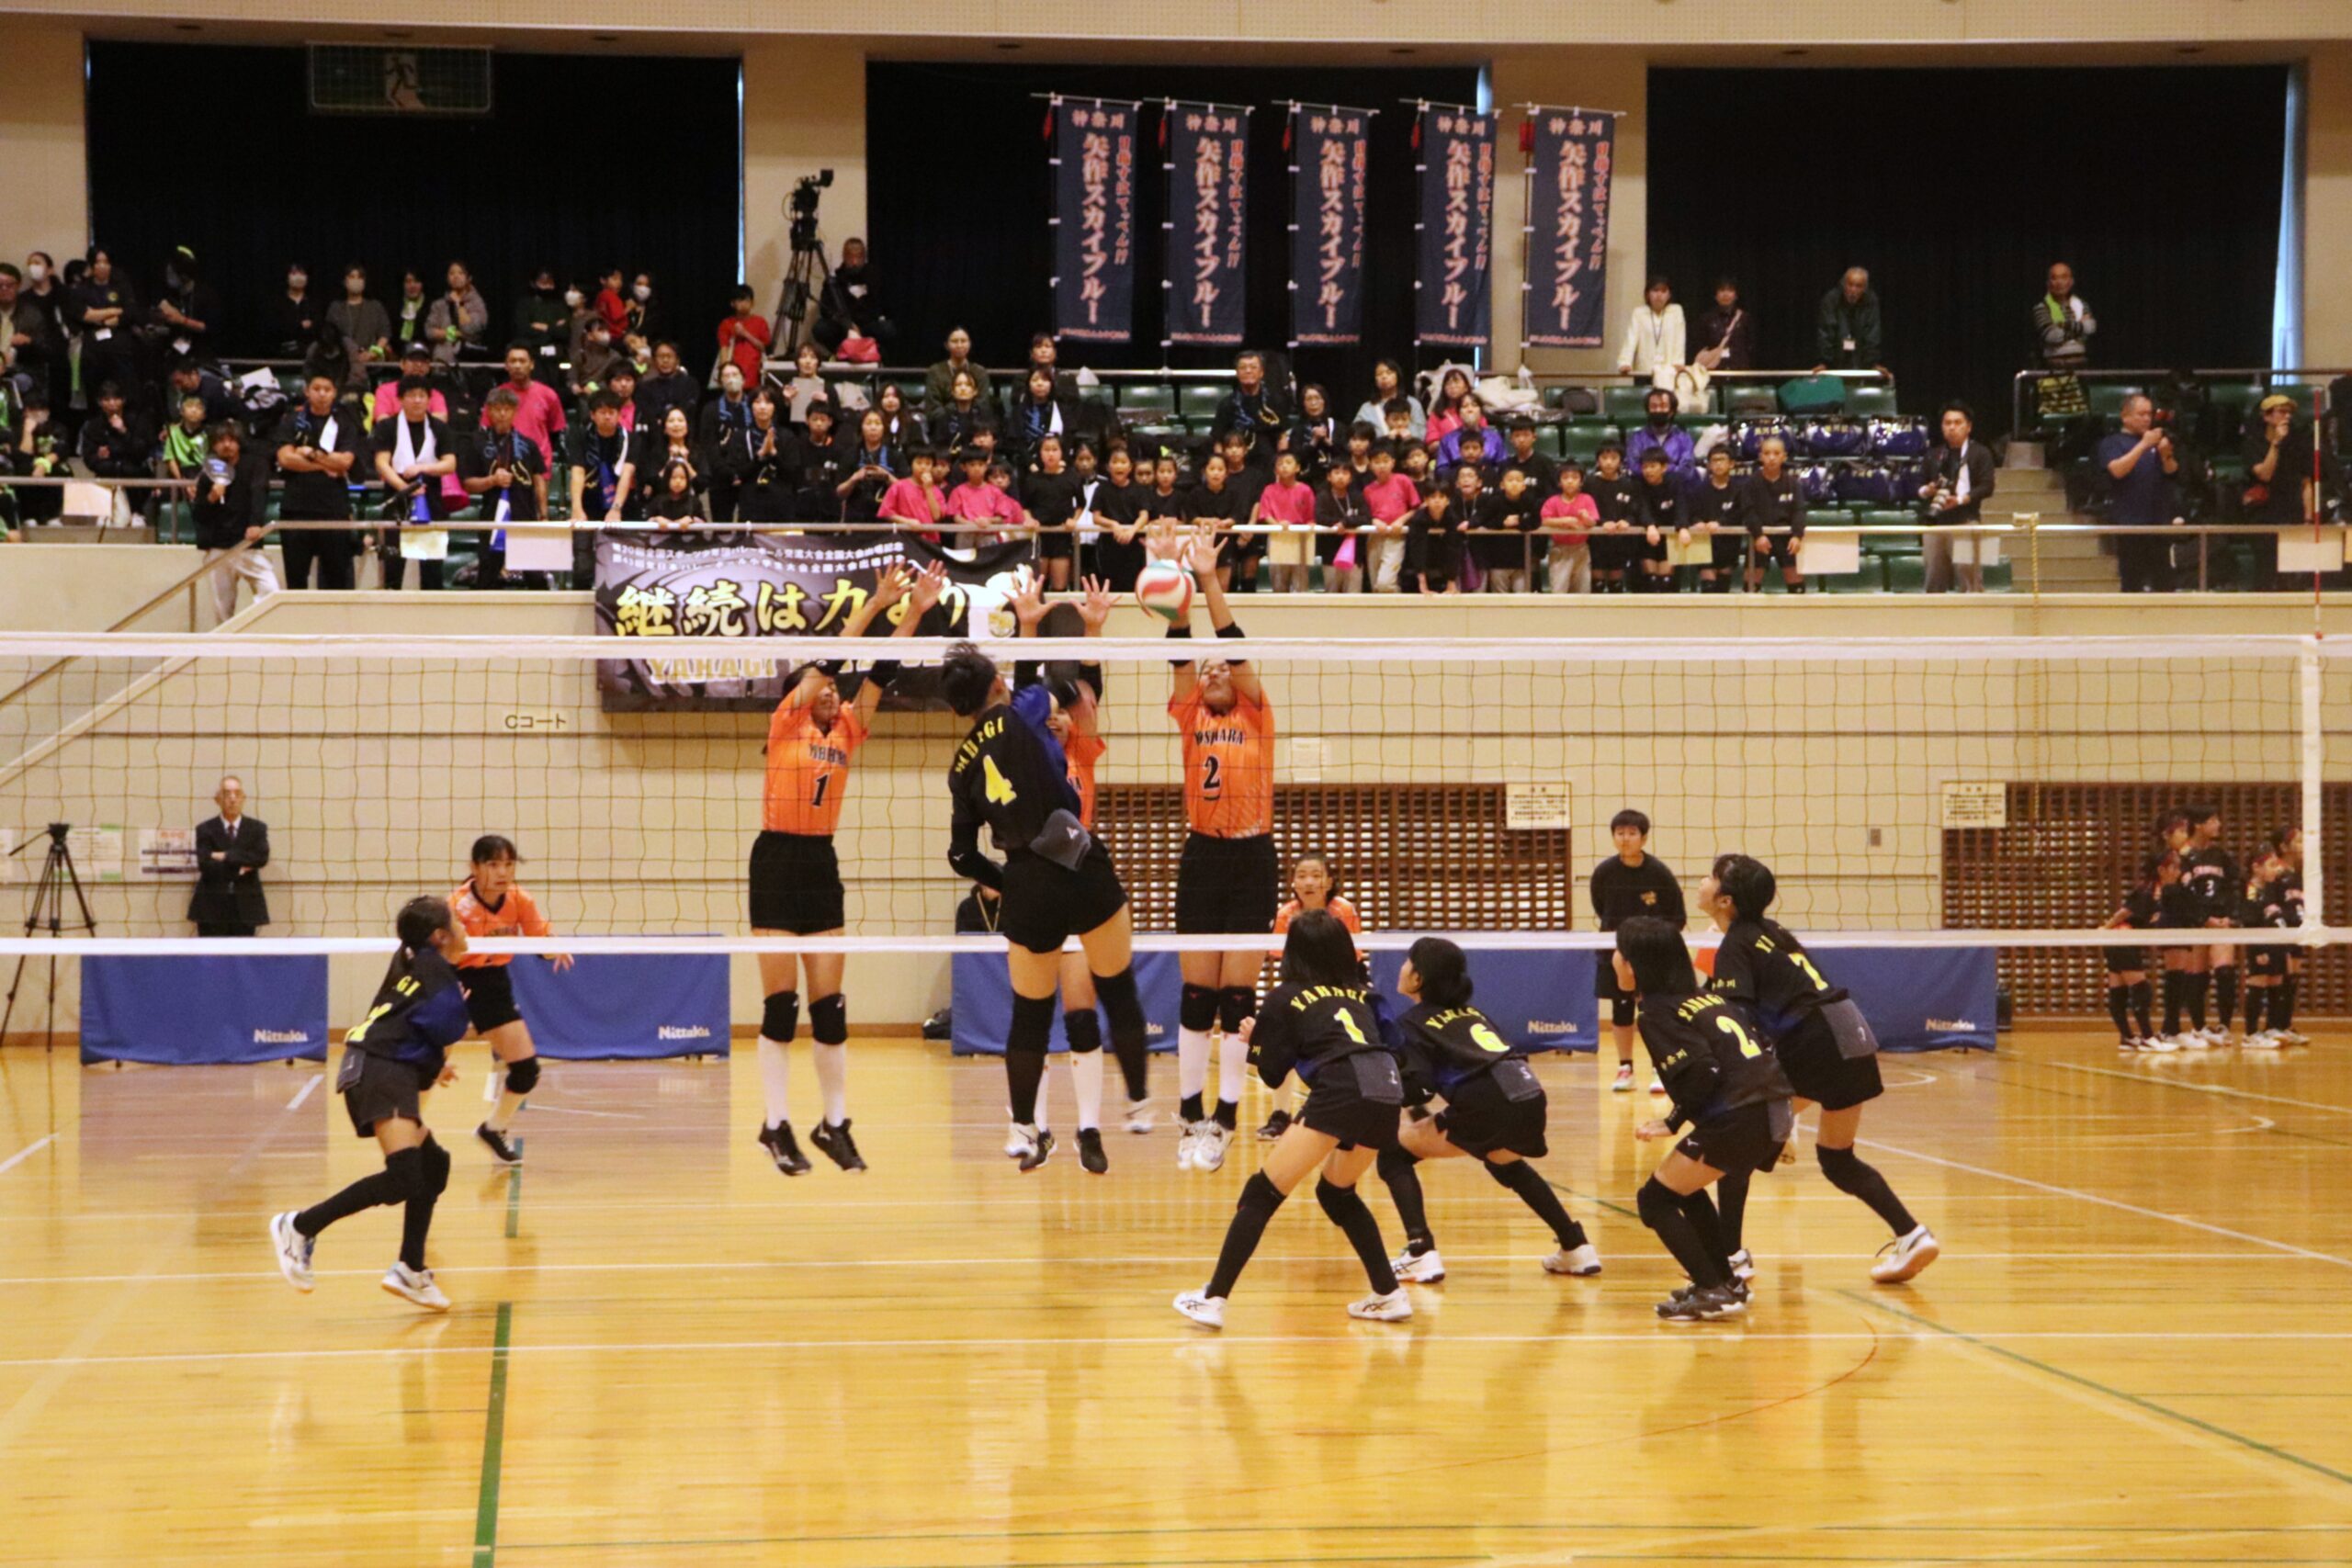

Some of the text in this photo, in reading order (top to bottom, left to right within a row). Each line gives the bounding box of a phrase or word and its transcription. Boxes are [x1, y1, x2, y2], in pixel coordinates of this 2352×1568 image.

[504, 713, 567, 729] Cコート
[983, 754, 1017, 806] 4
[1203, 755, 1220, 790] 2
[812, 773, 830, 807] 1
[1470, 1022, 1510, 1053] 6
[1715, 1015, 1762, 1059] 2
